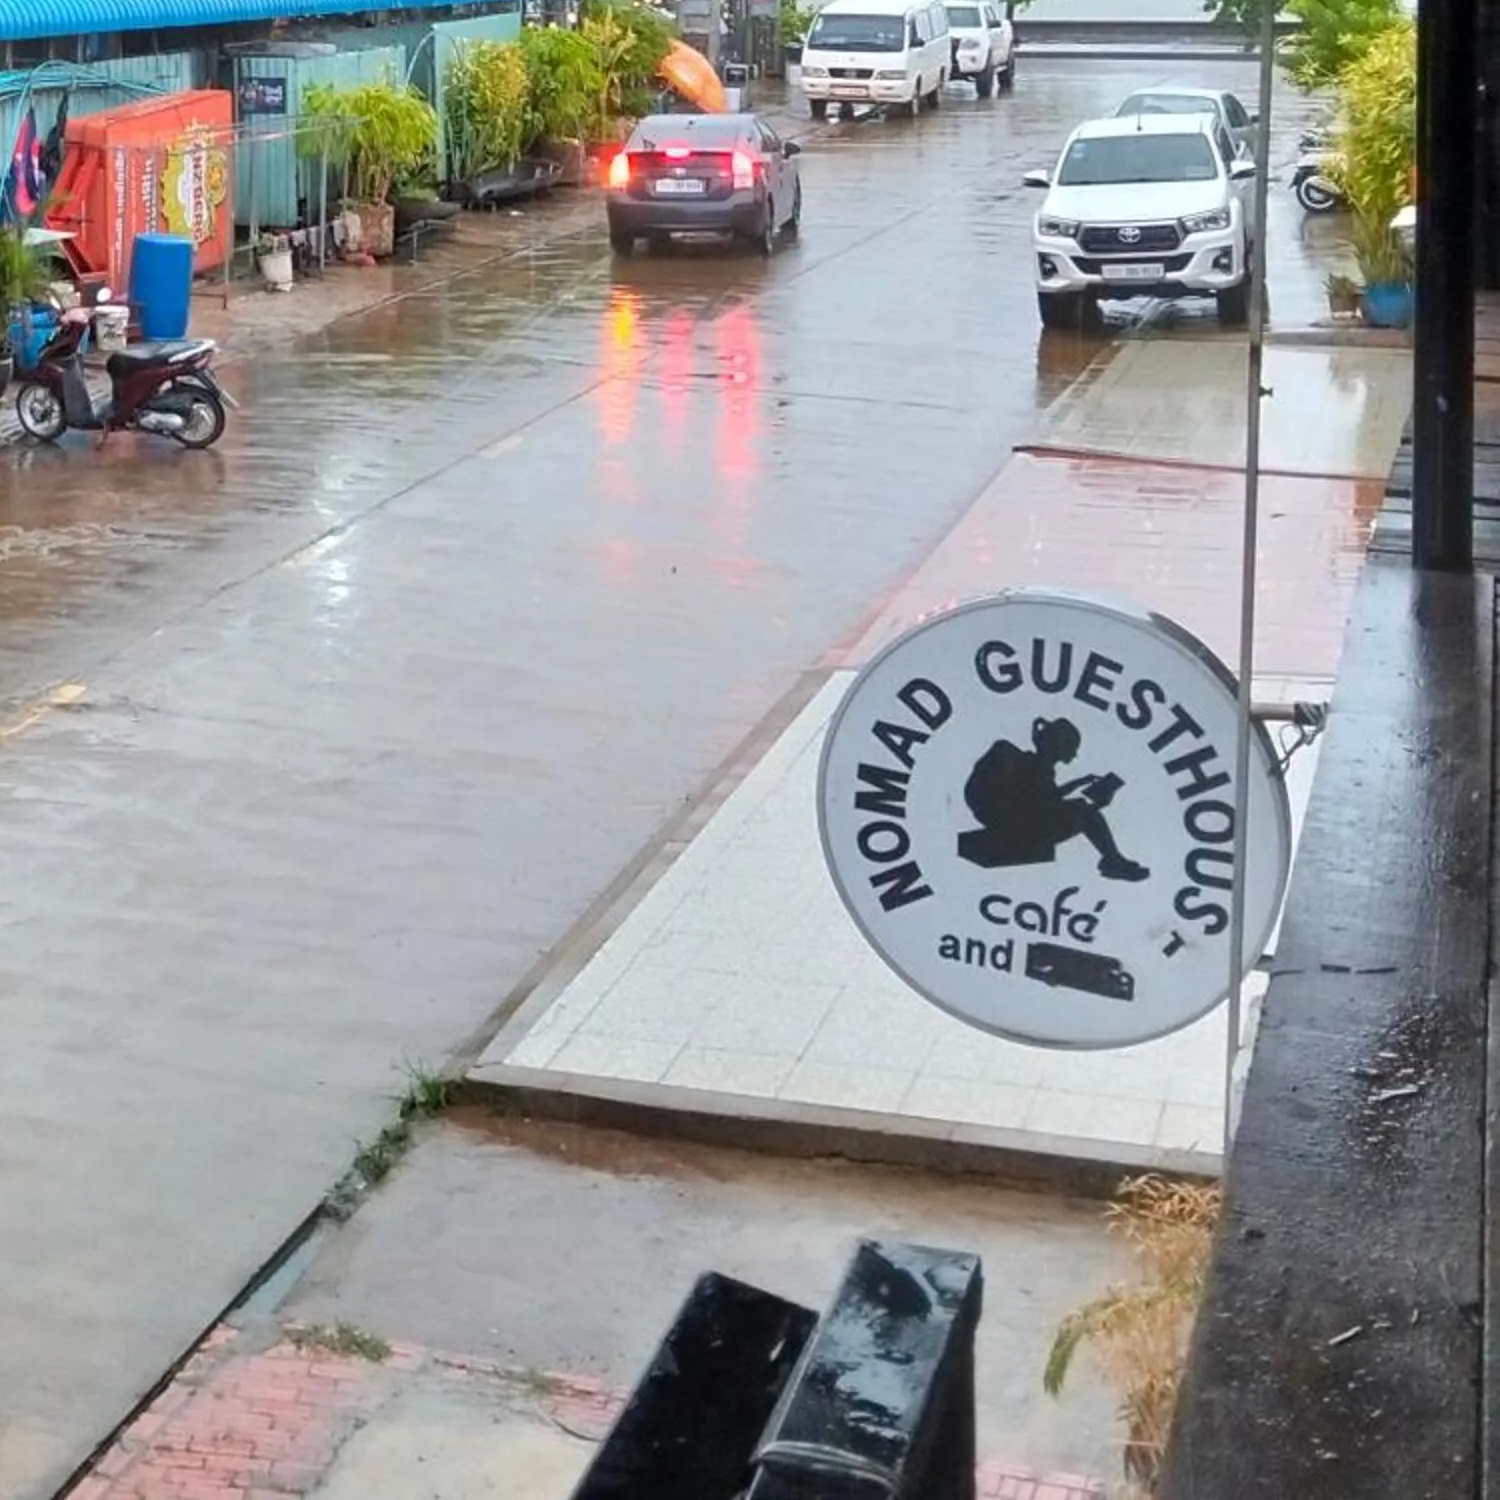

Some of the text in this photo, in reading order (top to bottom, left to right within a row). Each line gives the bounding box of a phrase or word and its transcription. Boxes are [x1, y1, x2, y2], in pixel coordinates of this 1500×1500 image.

[853, 637, 1238, 960] NOMAD GUESTHOUS
[938, 933, 1015, 974] and
